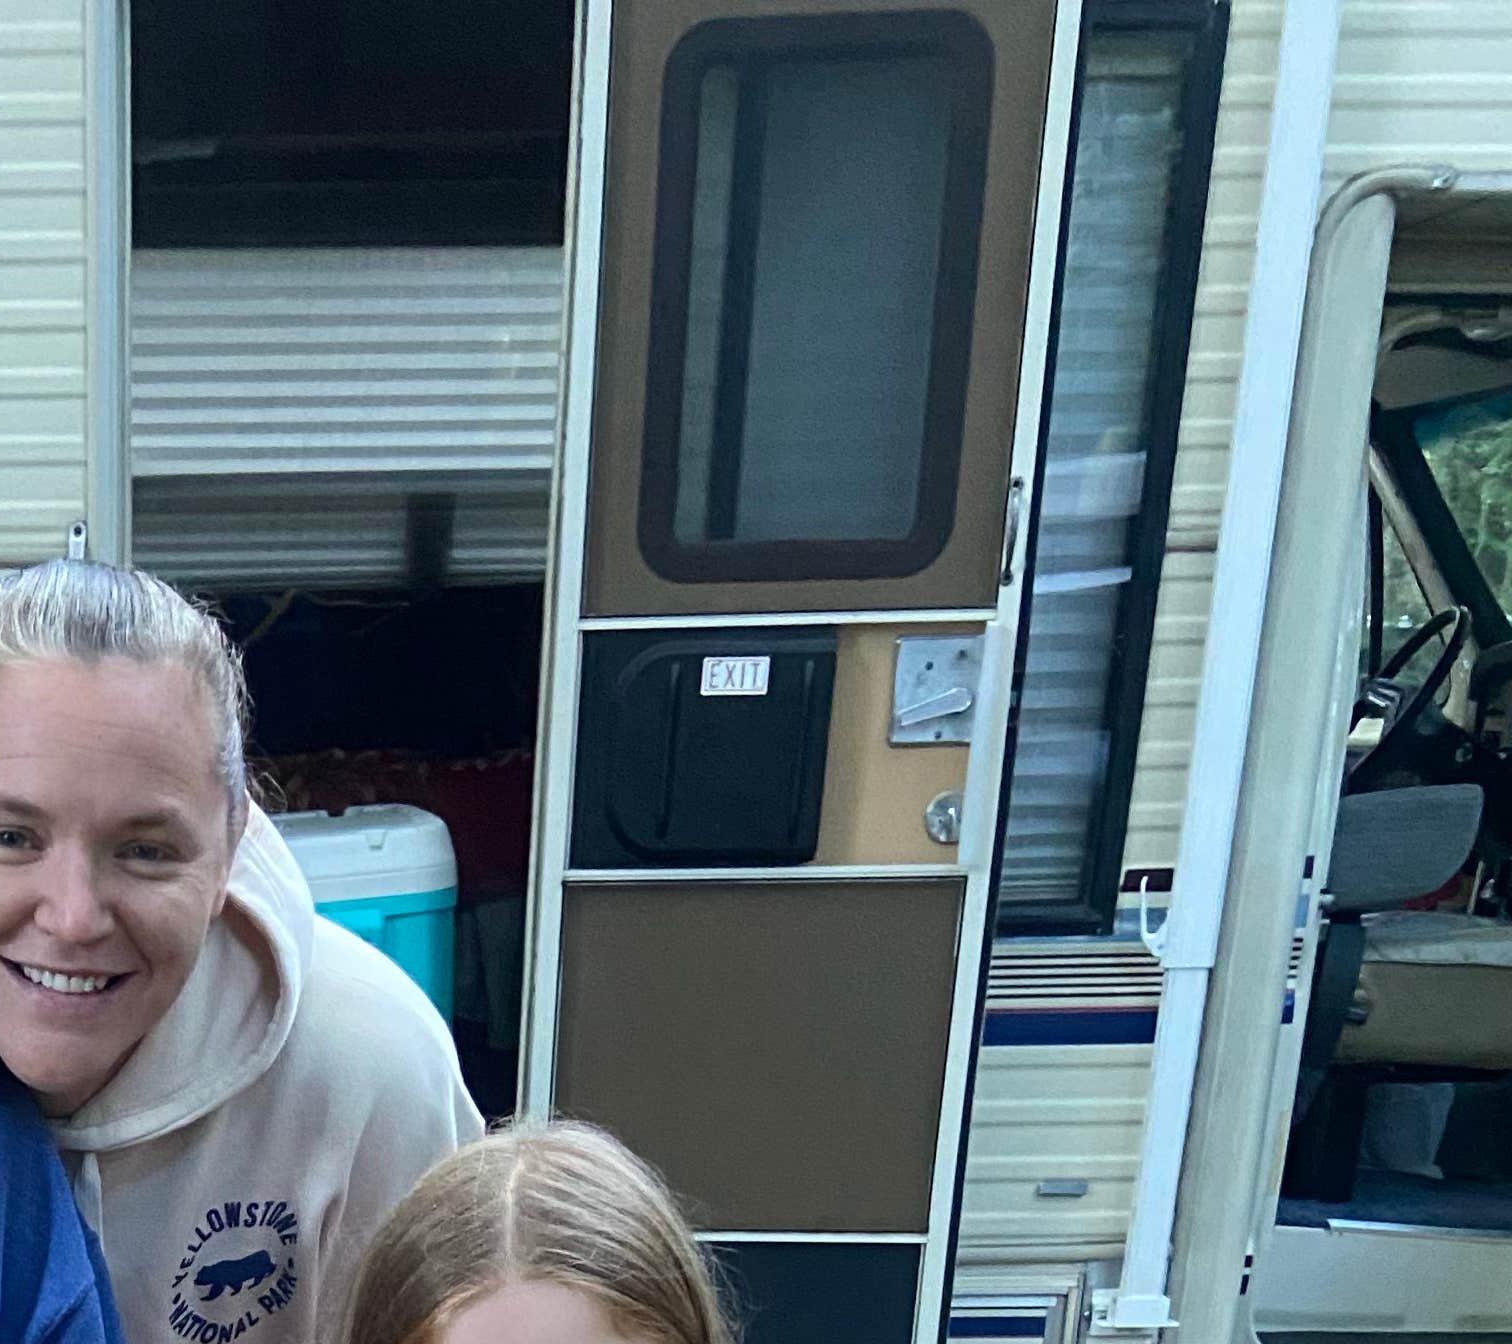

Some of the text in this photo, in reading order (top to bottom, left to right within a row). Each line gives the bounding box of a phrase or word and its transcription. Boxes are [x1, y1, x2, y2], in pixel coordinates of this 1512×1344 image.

[709, 660, 761, 690] EXIT
[172, 1201, 297, 1289] YELLOWSTONE
[258, 1271, 297, 1315] PARK
